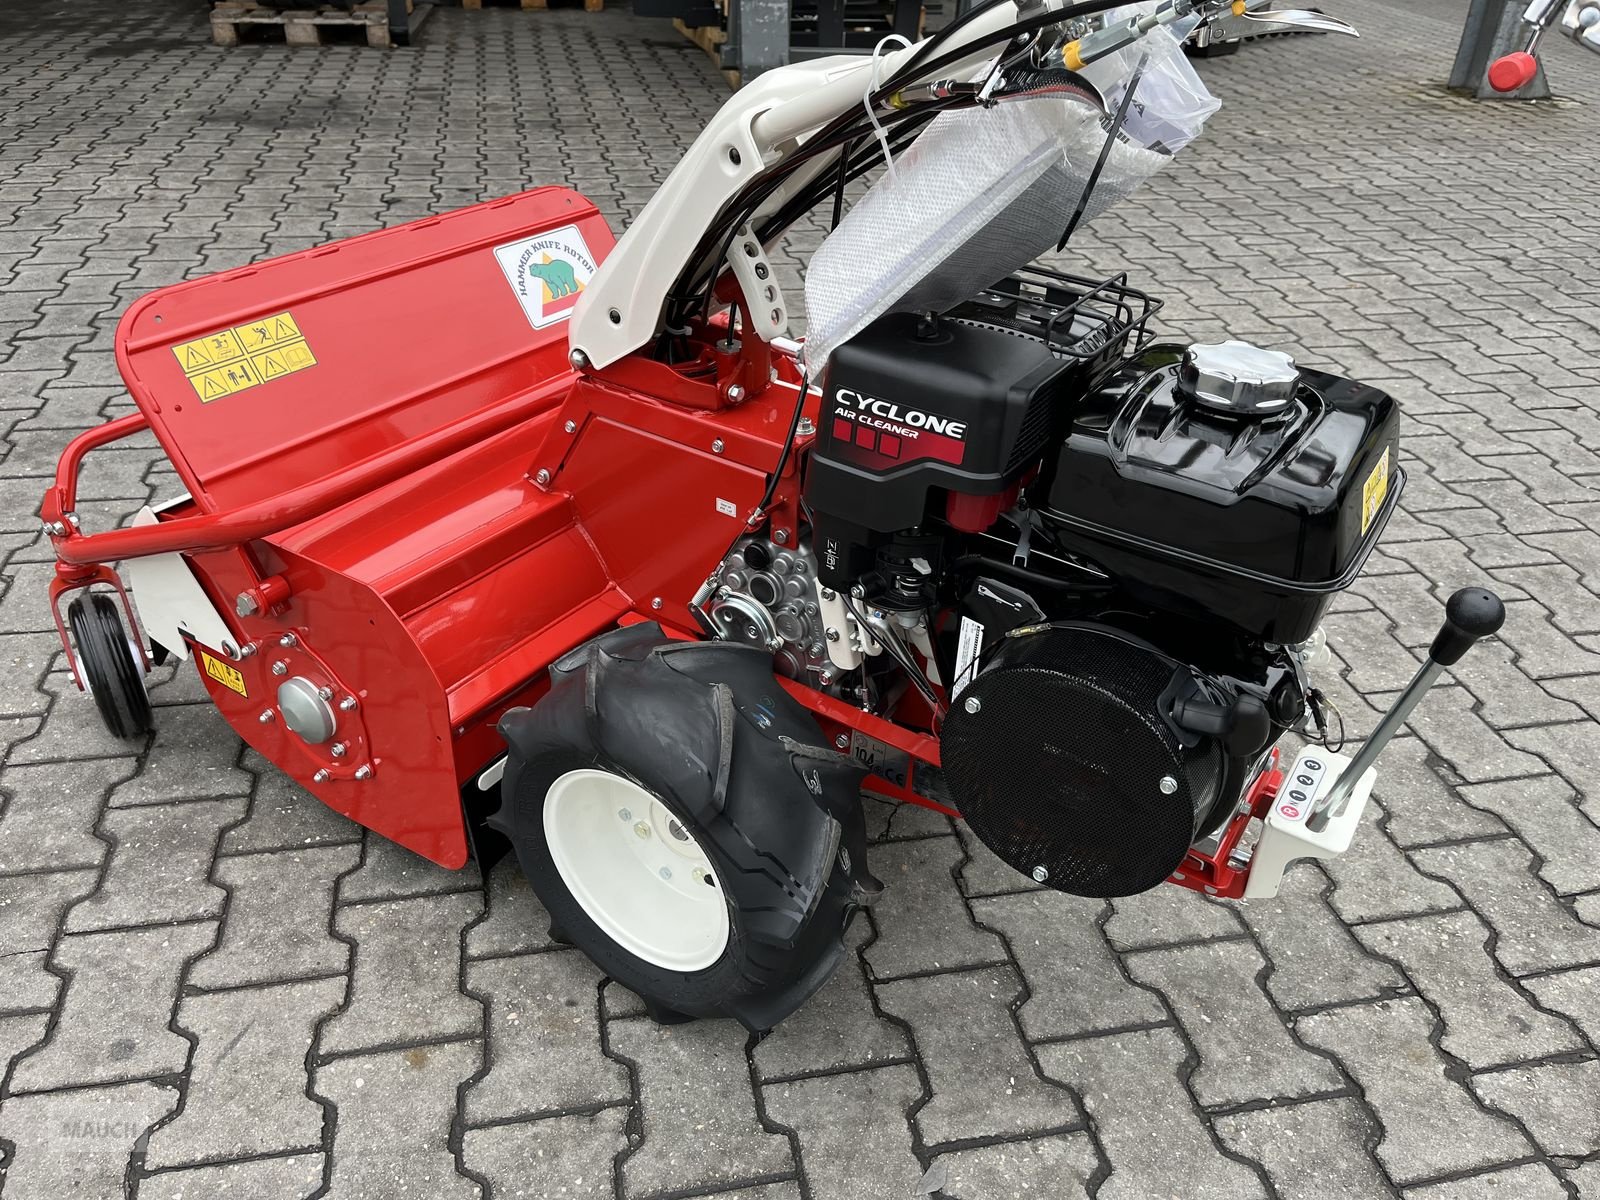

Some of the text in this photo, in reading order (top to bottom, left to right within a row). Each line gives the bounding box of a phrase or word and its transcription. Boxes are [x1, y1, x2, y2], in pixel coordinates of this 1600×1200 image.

[517, 240, 594, 296] HAMMER KNIFE ROTOR
[834, 407, 919, 439] AIR CLEANER
[835, 388, 966, 438] CYCLONE
